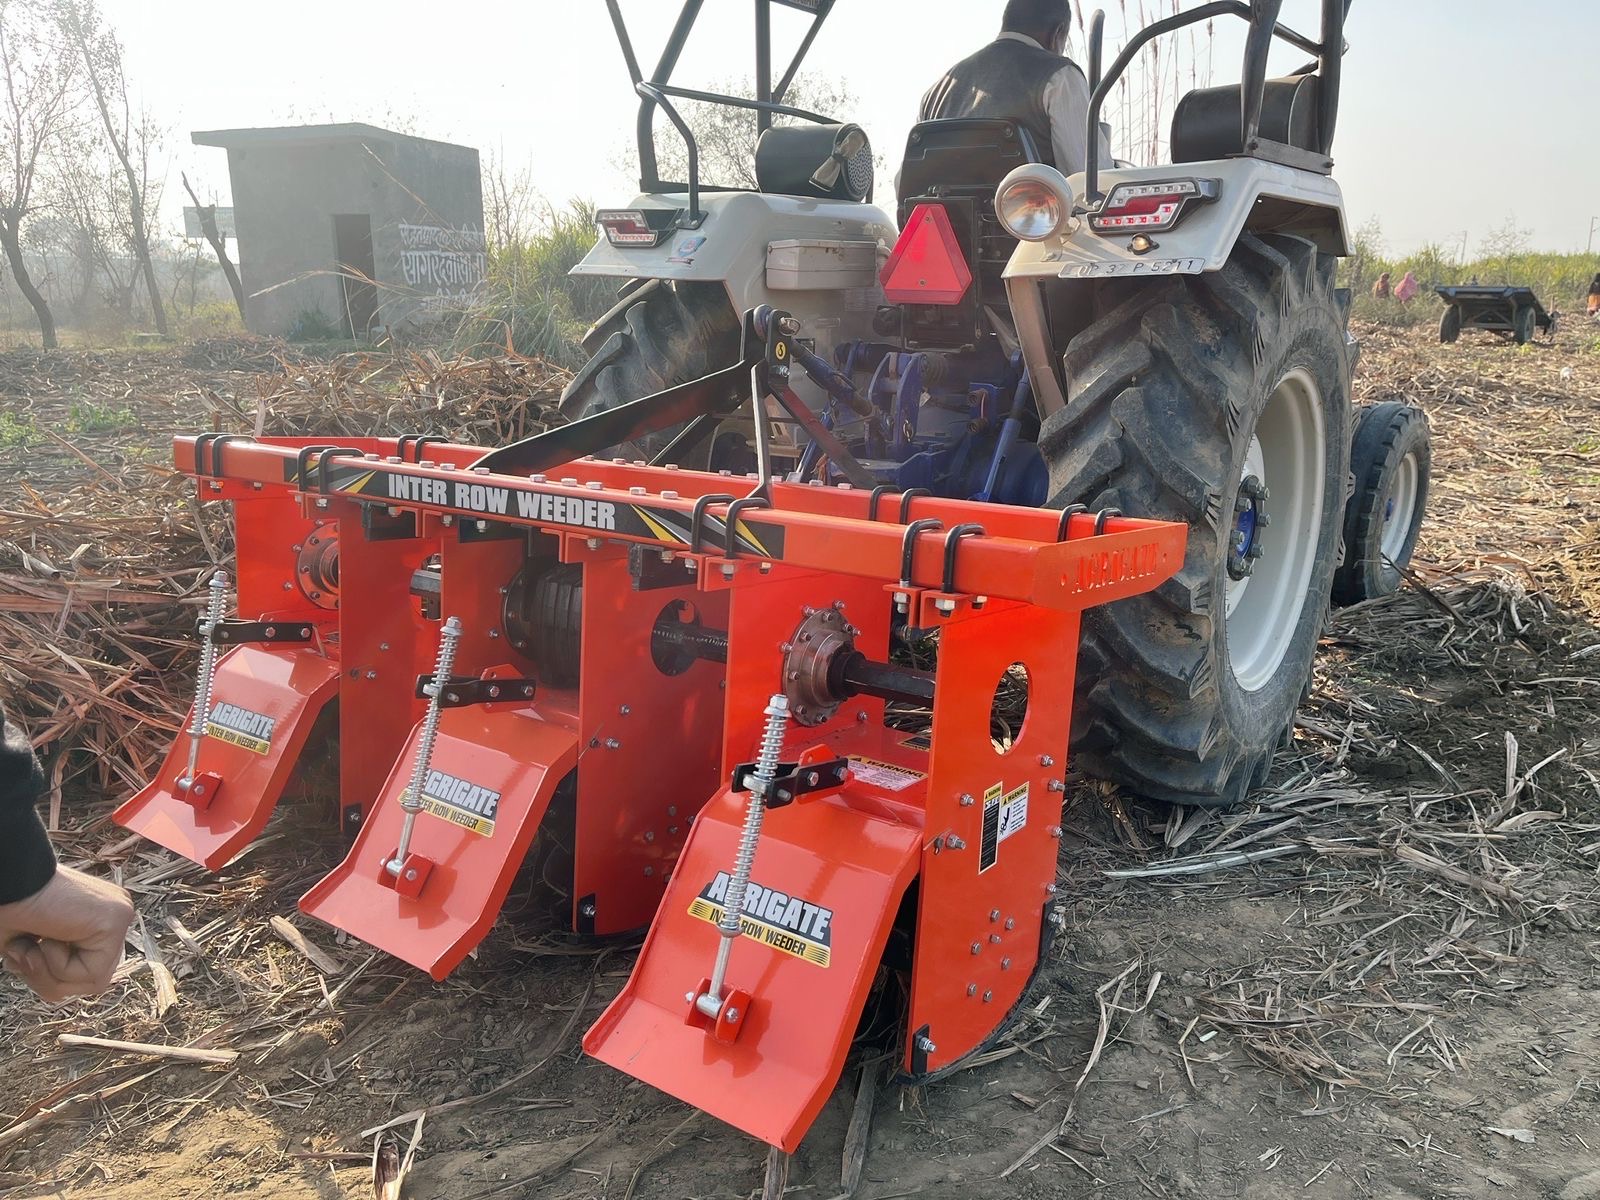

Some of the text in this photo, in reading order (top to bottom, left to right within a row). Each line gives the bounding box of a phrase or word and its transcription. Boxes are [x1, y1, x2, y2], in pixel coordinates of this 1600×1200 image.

[1133, 262, 1145, 272] P
[1151, 260, 1193, 272] 5211
[388, 473, 616, 530] INTER ROW WEEDER
[209, 701, 275, 740] AGRIGATE
[209, 726, 259, 750] INTER ROW WEEDER
[867, 760, 923, 778] WARNING
[432, 804, 449, 818] ROW
[450, 810, 479, 829] WEEDER
[707, 871, 832, 940] ARIGATE
[741, 920, 764, 939] ROW
[765, 929, 807, 956] WEEDER
